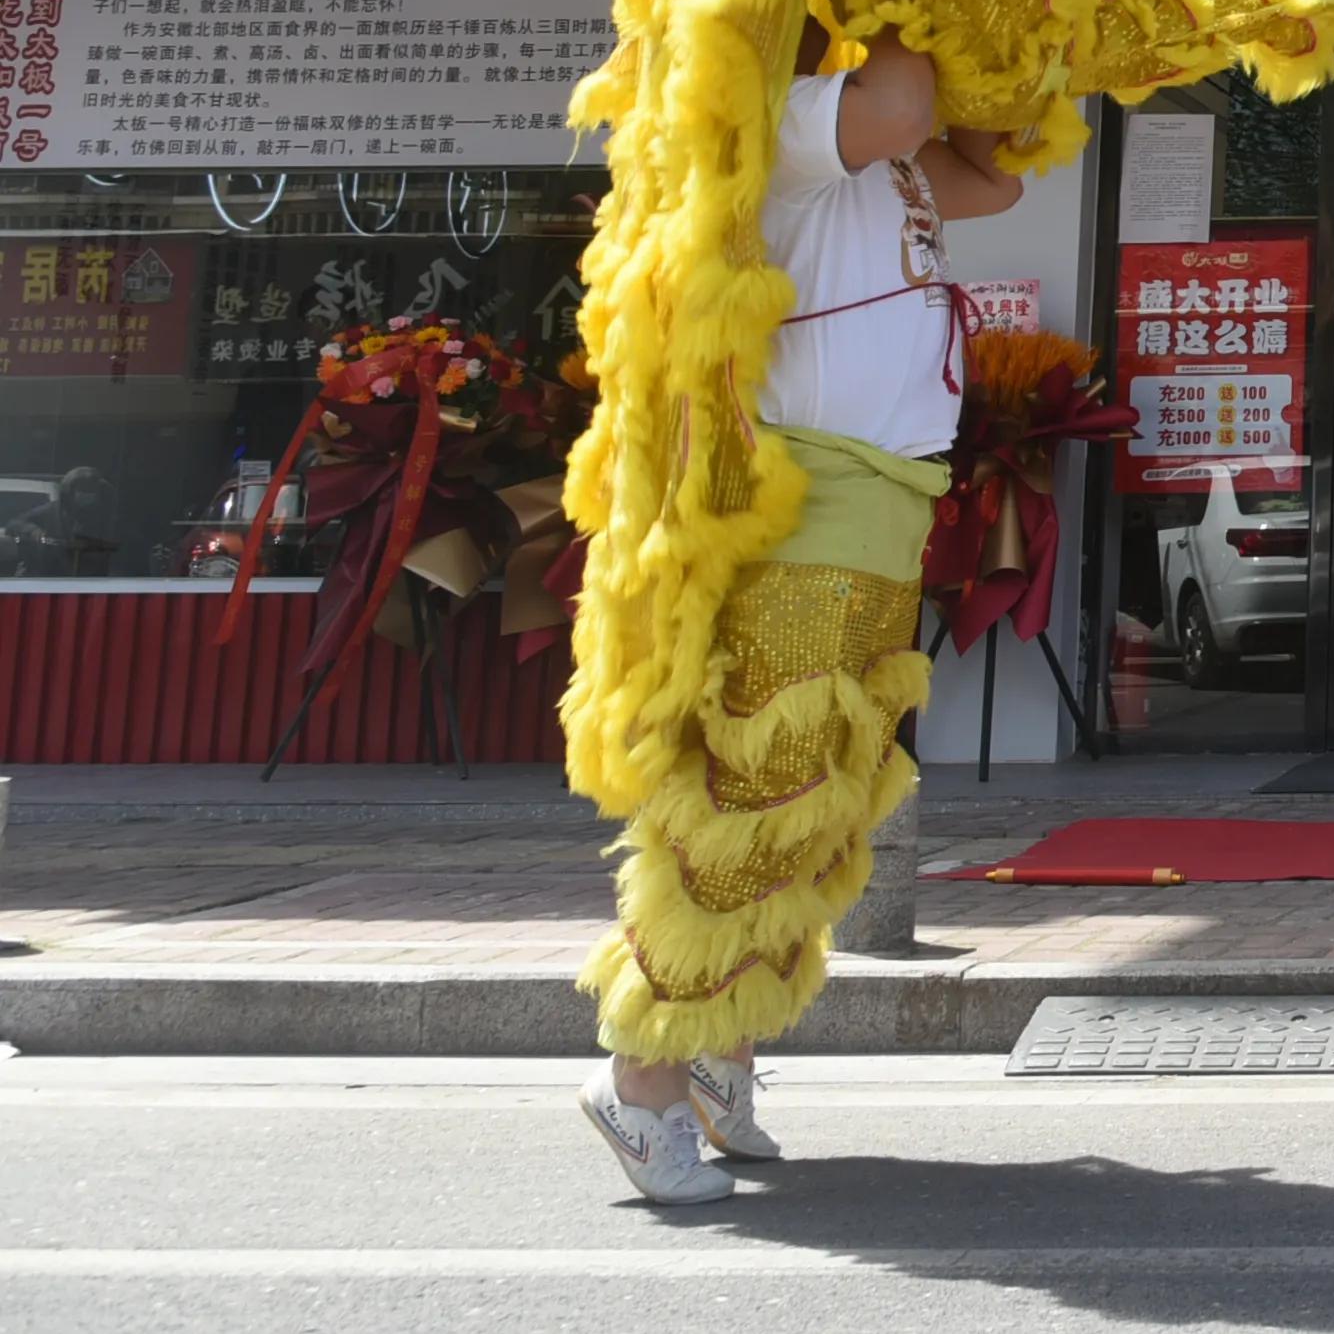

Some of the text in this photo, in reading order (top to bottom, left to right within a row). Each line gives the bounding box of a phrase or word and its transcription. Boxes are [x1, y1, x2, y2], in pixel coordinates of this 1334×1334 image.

[1138, 278, 1290, 314] 盛大开业
[1157, 384, 1206, 403] 充200
[1242, 385, 1267, 400] 100
[1157, 406, 1206, 424] 充500
[1242, 407, 1271, 422] 200
[1156, 428, 1212, 446] 充1000
[1242, 430, 1271, 444] 500
